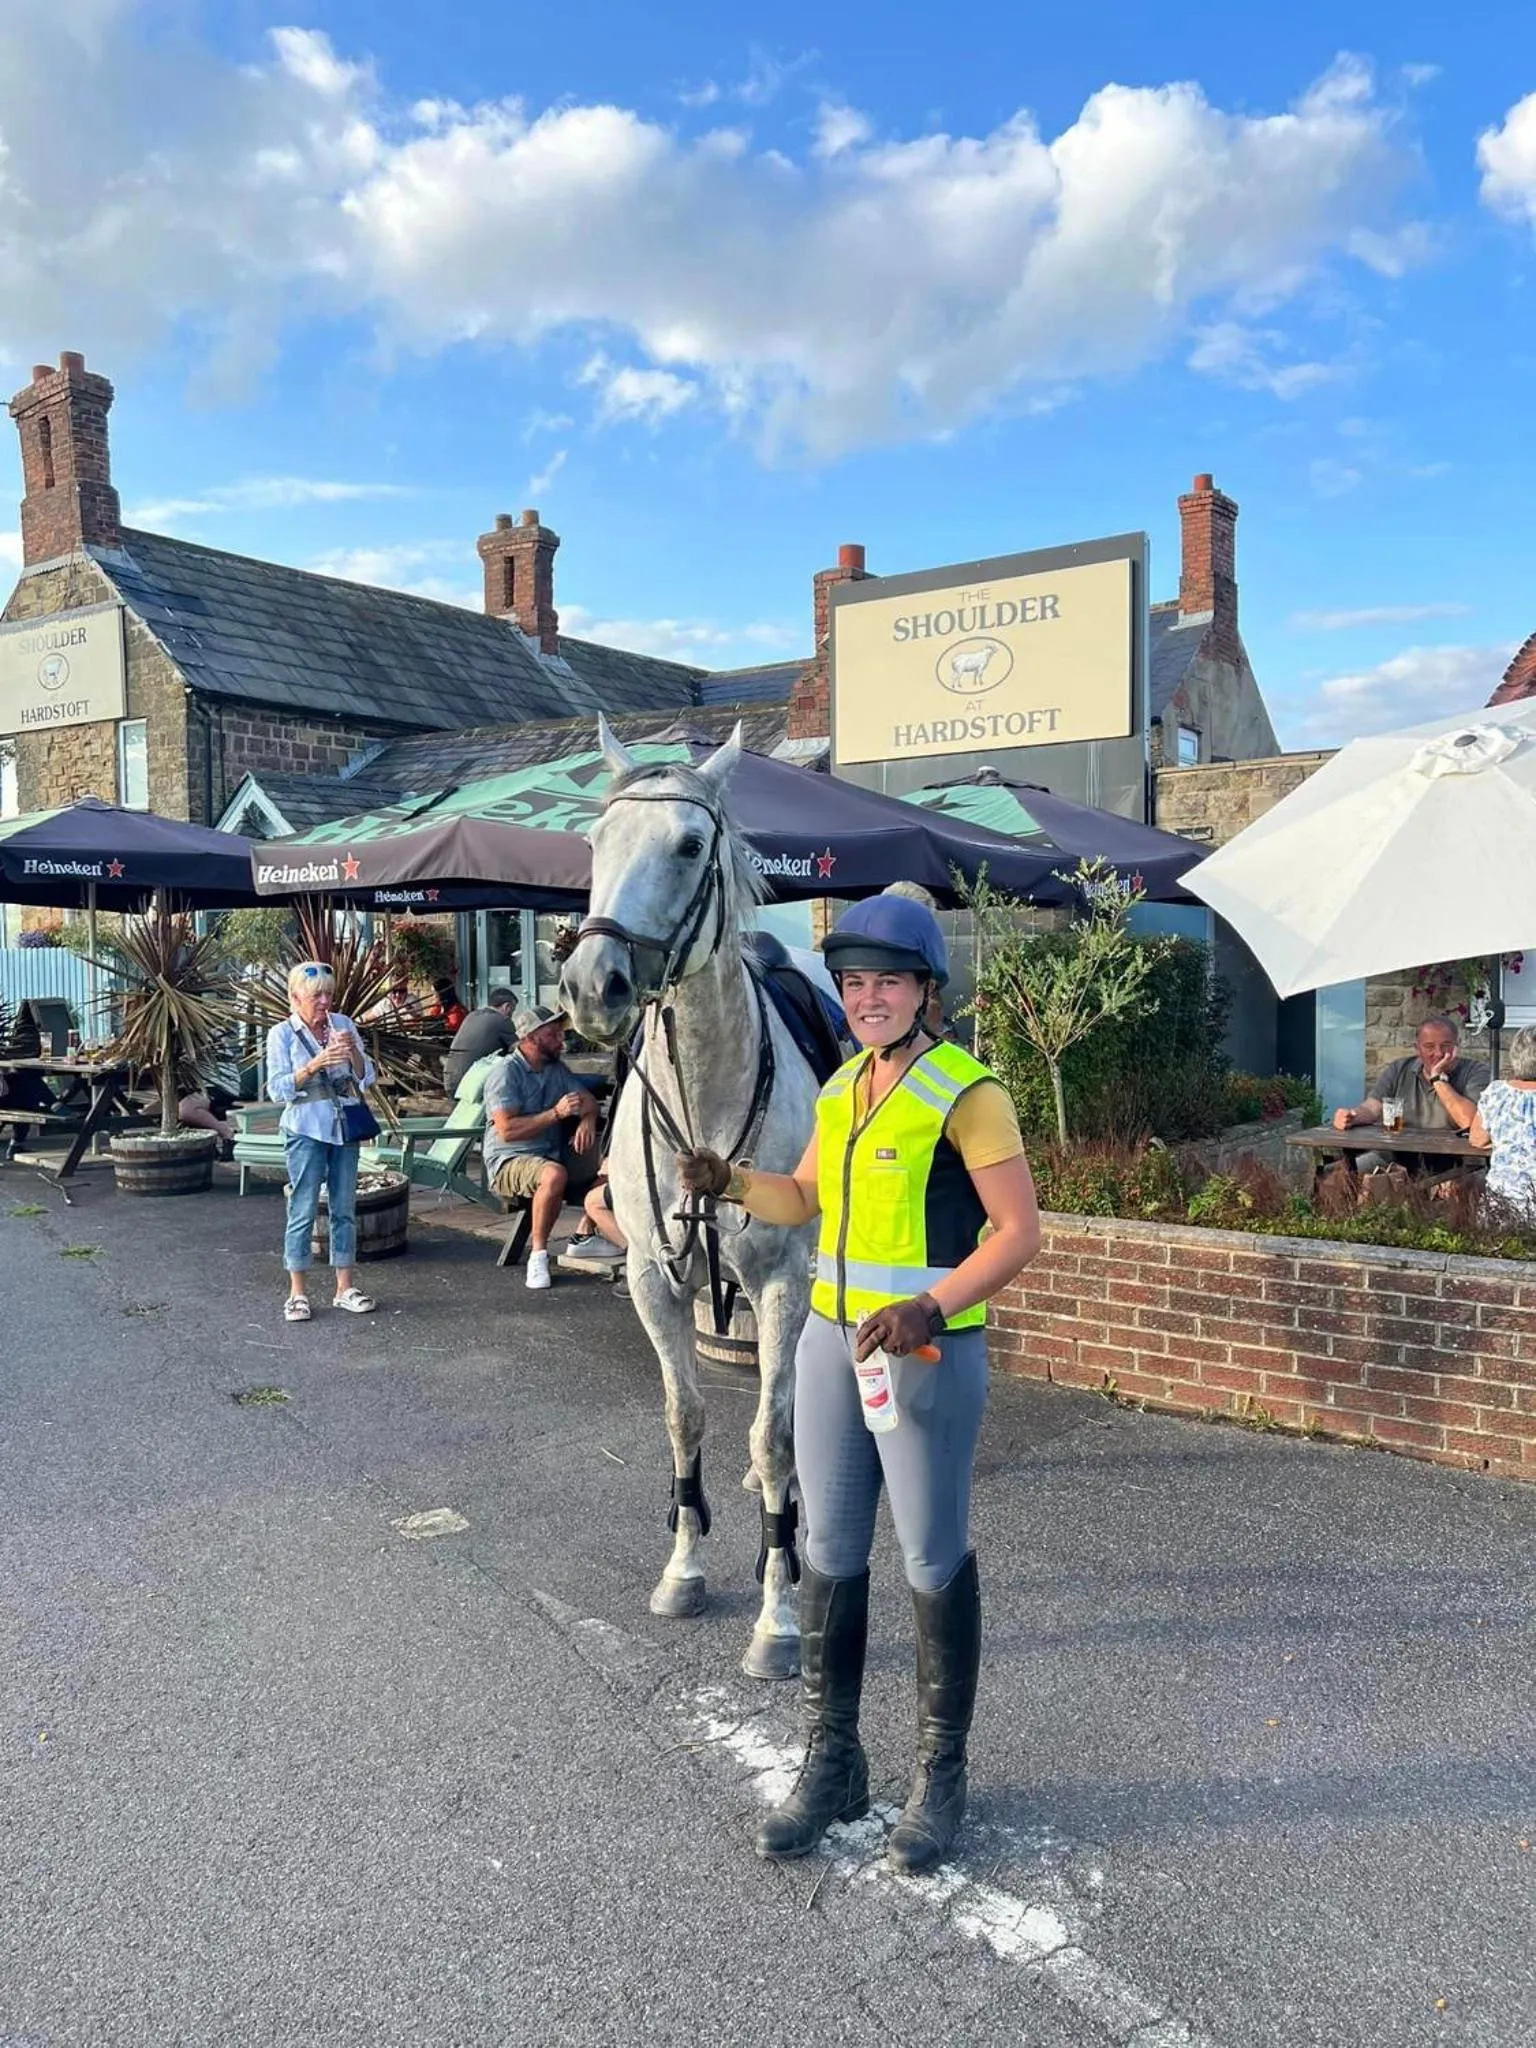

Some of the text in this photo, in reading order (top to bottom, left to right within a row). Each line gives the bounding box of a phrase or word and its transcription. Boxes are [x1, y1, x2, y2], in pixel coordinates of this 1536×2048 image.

[956, 588, 992, 603] THE
[893, 594, 1062, 642] SHOULDER
[19, 627, 87, 654] SHOULDER
[21, 700, 90, 723] HARDSTOFT
[965, 699, 985, 712] AT
[893, 708, 1062, 747] HARDSTOFT
[23, 859, 103, 876] Heineken
[257, 861, 339, 885] Heineken
